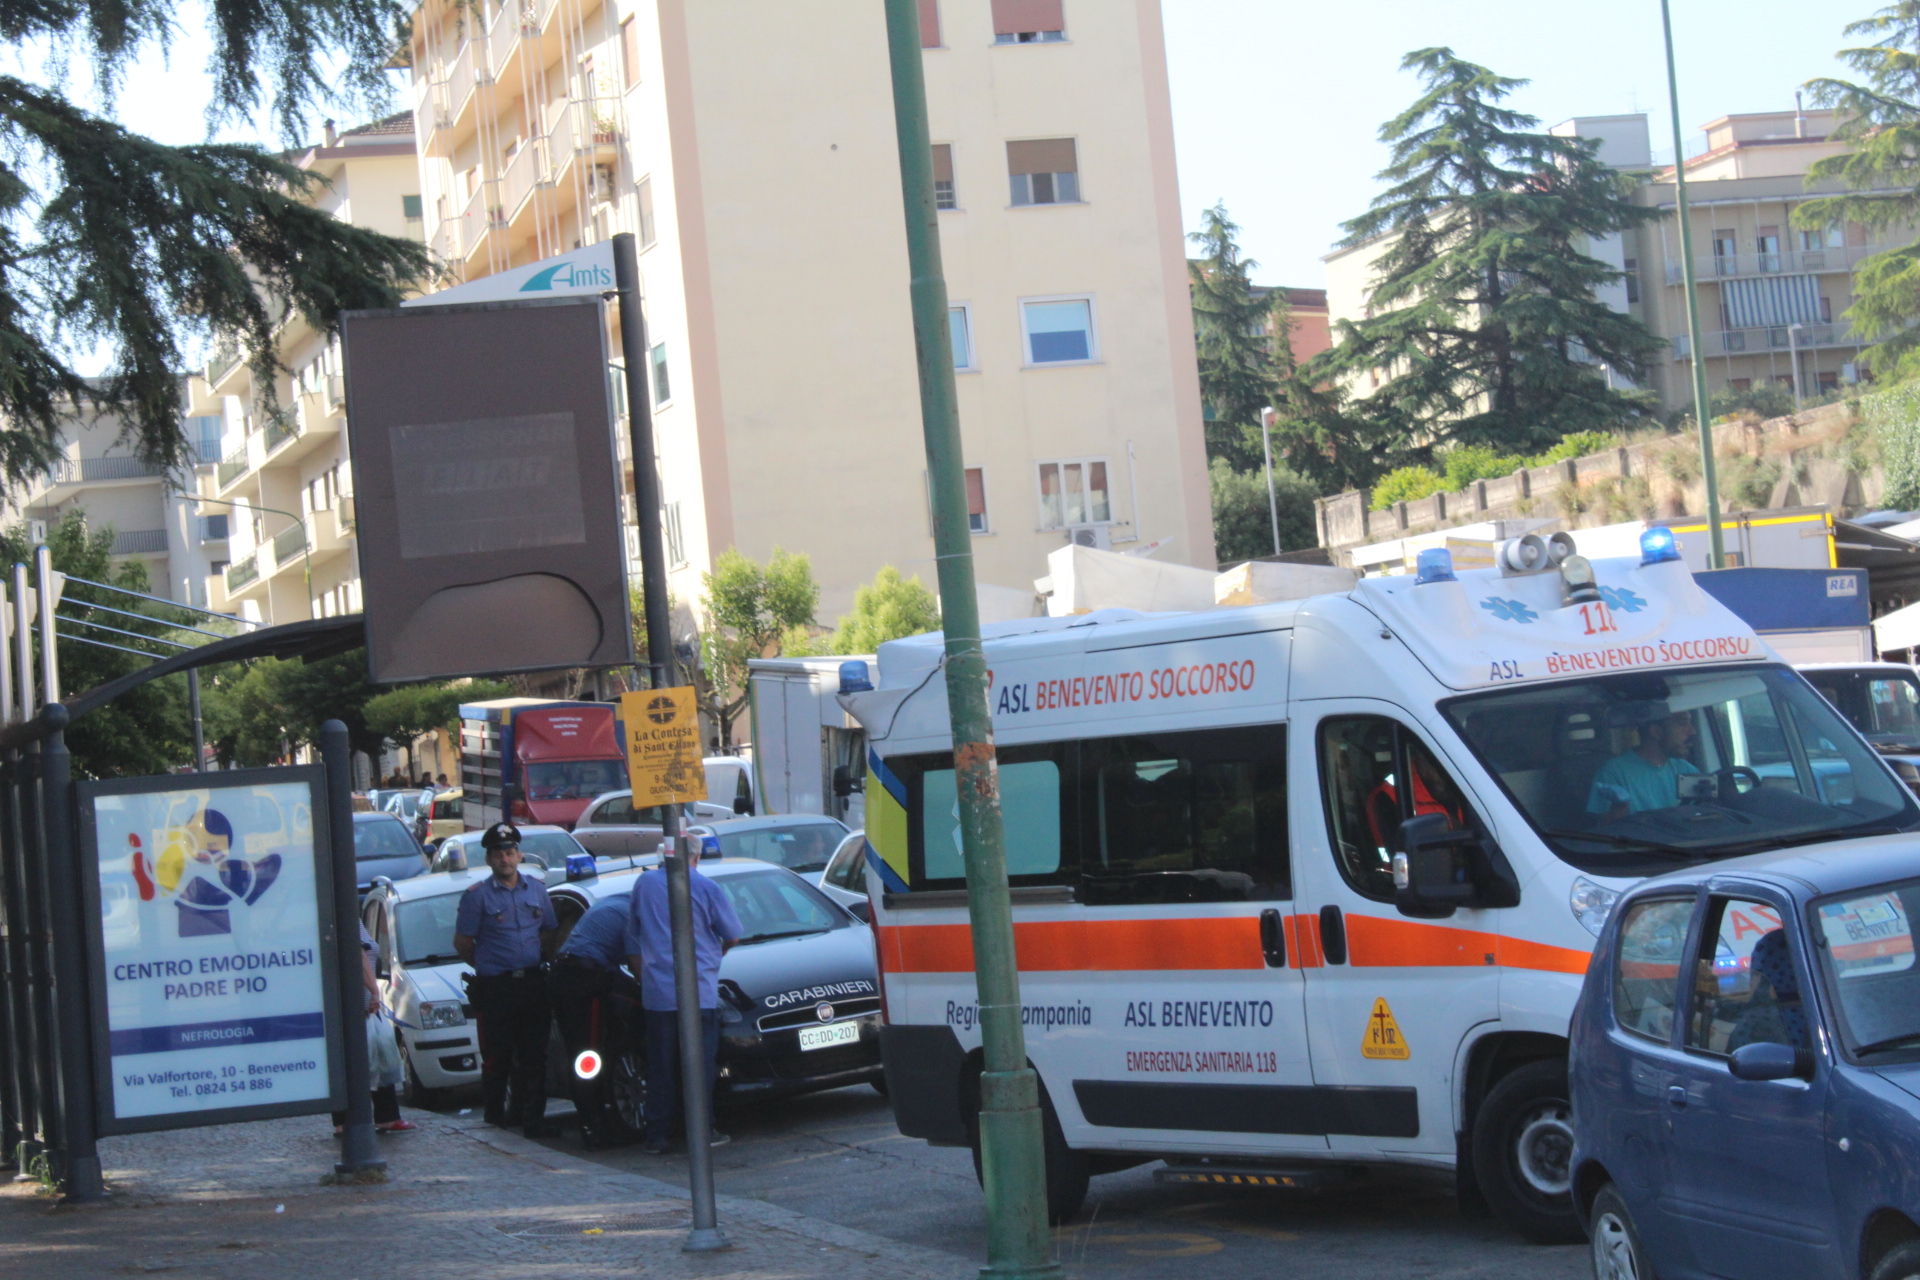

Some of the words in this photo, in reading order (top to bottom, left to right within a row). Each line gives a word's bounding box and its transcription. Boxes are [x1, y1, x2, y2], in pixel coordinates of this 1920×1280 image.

[1829, 578, 1855, 591] REA
[1490, 660, 1524, 681] ASL
[1545, 645, 1656, 675] BENEVENTO
[997, 683, 1030, 715] ASL
[1036, 671, 1144, 711] BENEVENTO
[1149, 659, 1255, 700] SOCCORSO
[634, 731, 648, 741] La
[114, 959, 193, 981] CENTRO
[200, 949, 313, 974] EMODIALISI
[164, 980, 227, 1000] PADRE
[234, 976, 268, 993] PIO
[765, 980, 873, 1007] CARABINIERI
[1022, 999, 1091, 1031] ampania
[1124, 1001, 1156, 1027] ASL
[1161, 1000, 1273, 1027] BENEVENTO
[181, 1027, 254, 1042] NEFROLOGIA
[838, 1026, 857, 1040] 207
[124, 1075, 144, 1086] Via
[148, 1069, 217, 1084] Valfortore,
[221, 1067, 236, 1077] 10
[248, 1060, 316, 1075] Benevento
[1126, 1051, 1192, 1072] EMERGENZA
[1195, 1051, 1253, 1072] SANITARIA
[1257, 1051, 1277, 1073] 118
[170, 1086, 191, 1098] Tel.
[196, 1082, 227, 1095] 0824
[230, 1081, 246, 1091] 54
[249, 1078, 273, 1089] 886
